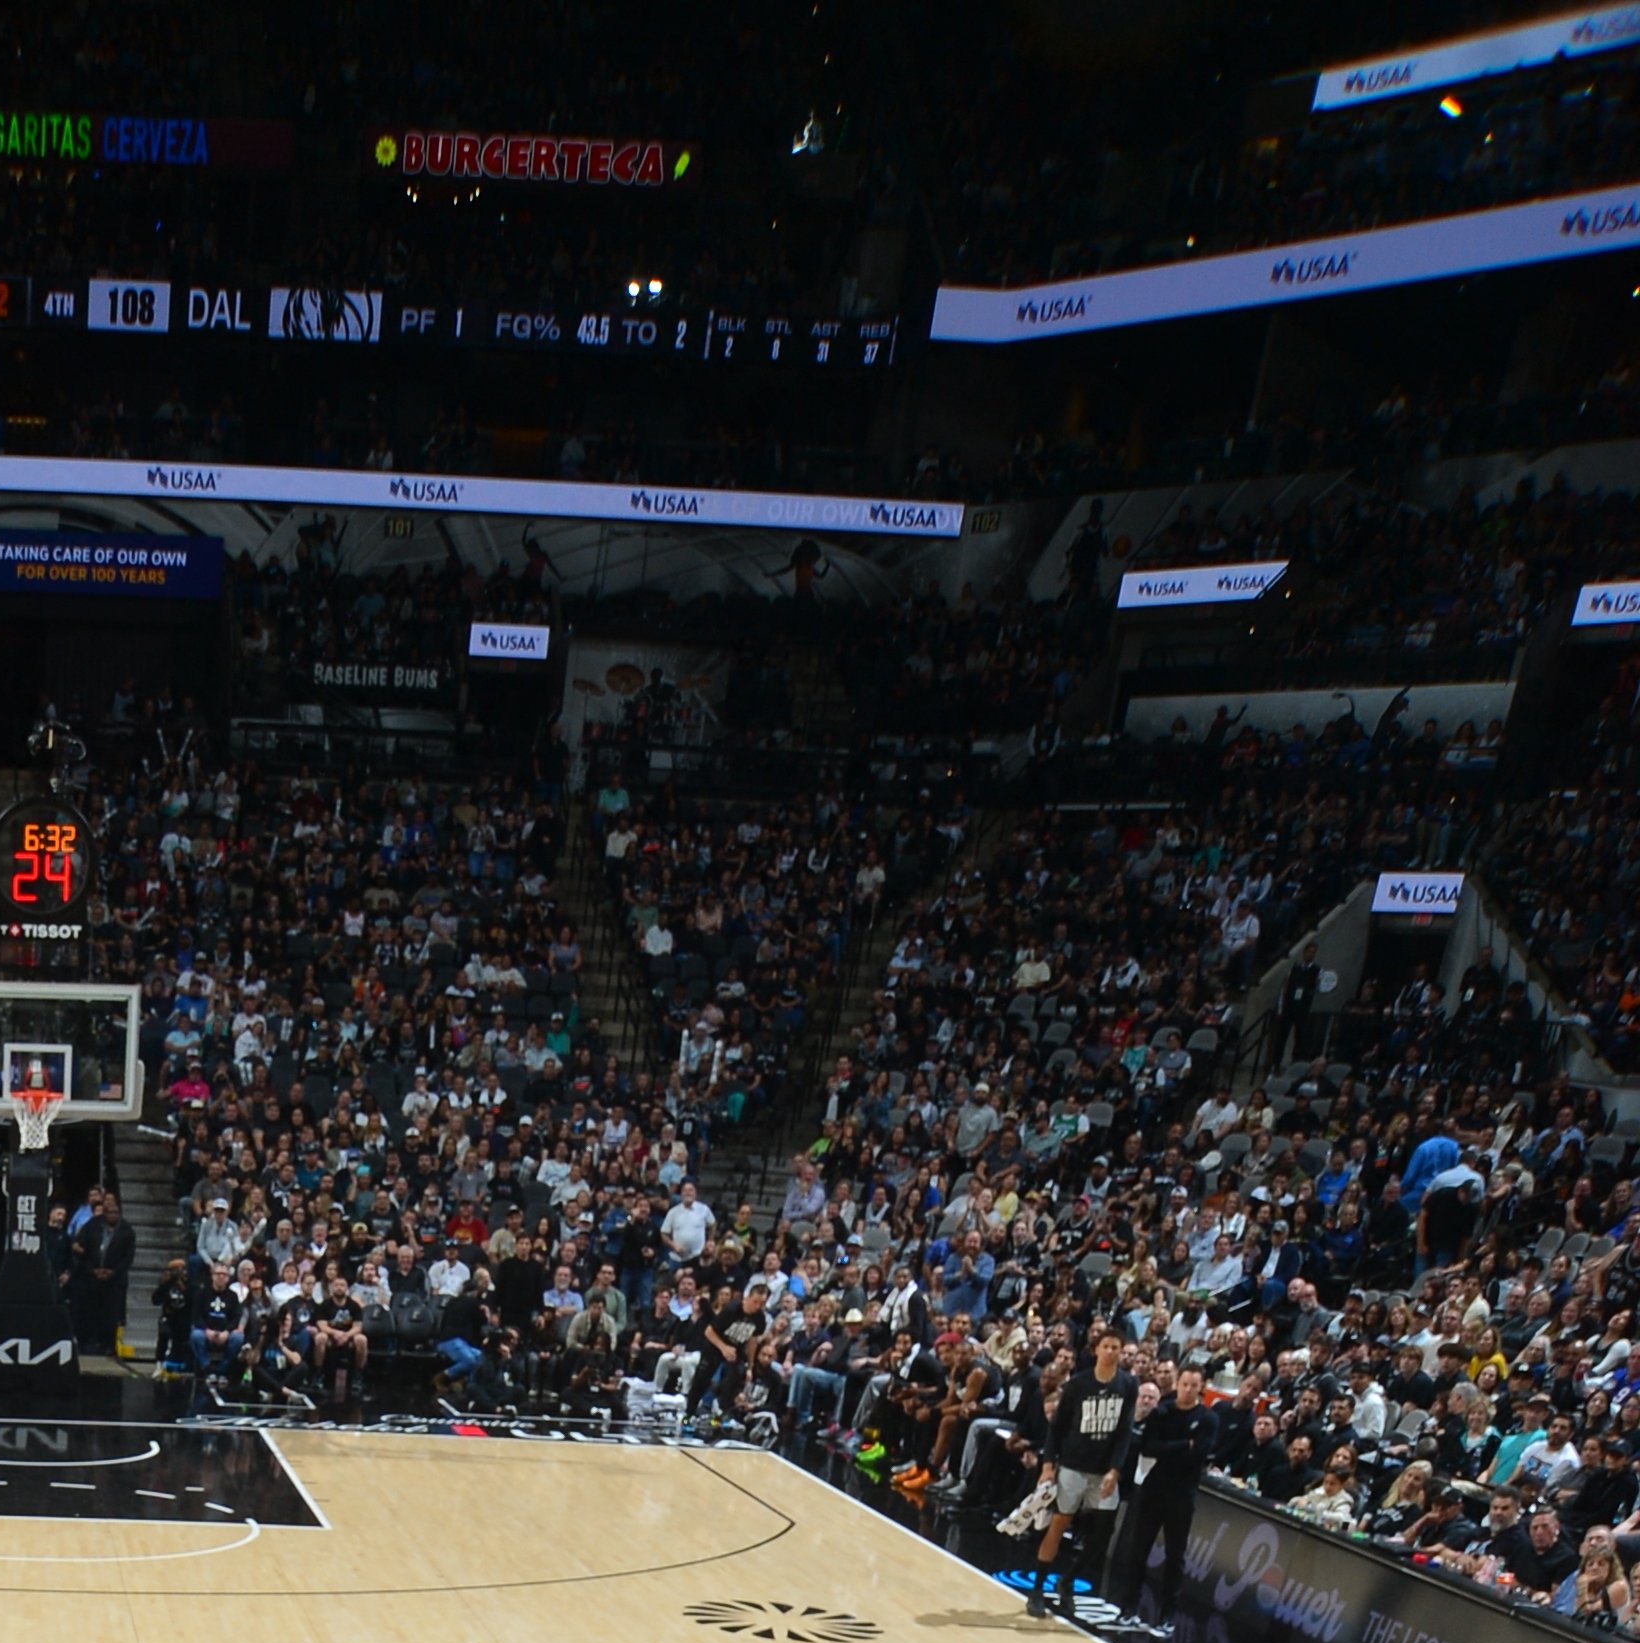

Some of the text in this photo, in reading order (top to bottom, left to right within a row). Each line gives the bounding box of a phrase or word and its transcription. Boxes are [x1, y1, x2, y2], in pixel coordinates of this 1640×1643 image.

[1365, 63, 1413, 93] USAA
[101, 115, 210, 166] CERVEZA
[402, 131, 665, 187] BURGERTECA
[1591, 200, 1640, 234] USA
[1295, 253, 1351, 285] USAA
[43, 291, 75, 319] 4TH
[108, 287, 157, 328] 108
[187, 287, 252, 331] DAL
[1039, 295, 1087, 325] USAA
[401, 307, 436, 334] PF
[495, 311, 562, 341] FG%
[576, 312, 611, 347] 43.5
[622, 319, 658, 347] TO
[674, 318, 688, 351] 2
[718, 316, 891, 340] BLK STL AST REB
[170, 470, 218, 492] USAA
[413, 481, 459, 504] USAA
[652, 494, 700, 517] USAA
[892, 506, 938, 530] USAA
[54, 546, 92, 564] CARE
[94, 547, 114, 564] OF
[117, 548, 148, 565] OUR
[151, 551, 188, 568] OWN
[16, 564, 167, 586] FOR OVER 100 YEARS
[1153, 579, 1185, 597] USAA
[1615, 591, 1640, 615] US
[499, 633, 537, 653] USAA
[313, 662, 439, 690] BASELINE BUMS
[24, 823, 77, 853] 6:32
[12, 852, 71, 902] 24
[21, 923, 82, 939] TISSOT
[16, 1195, 37, 1213] GET
